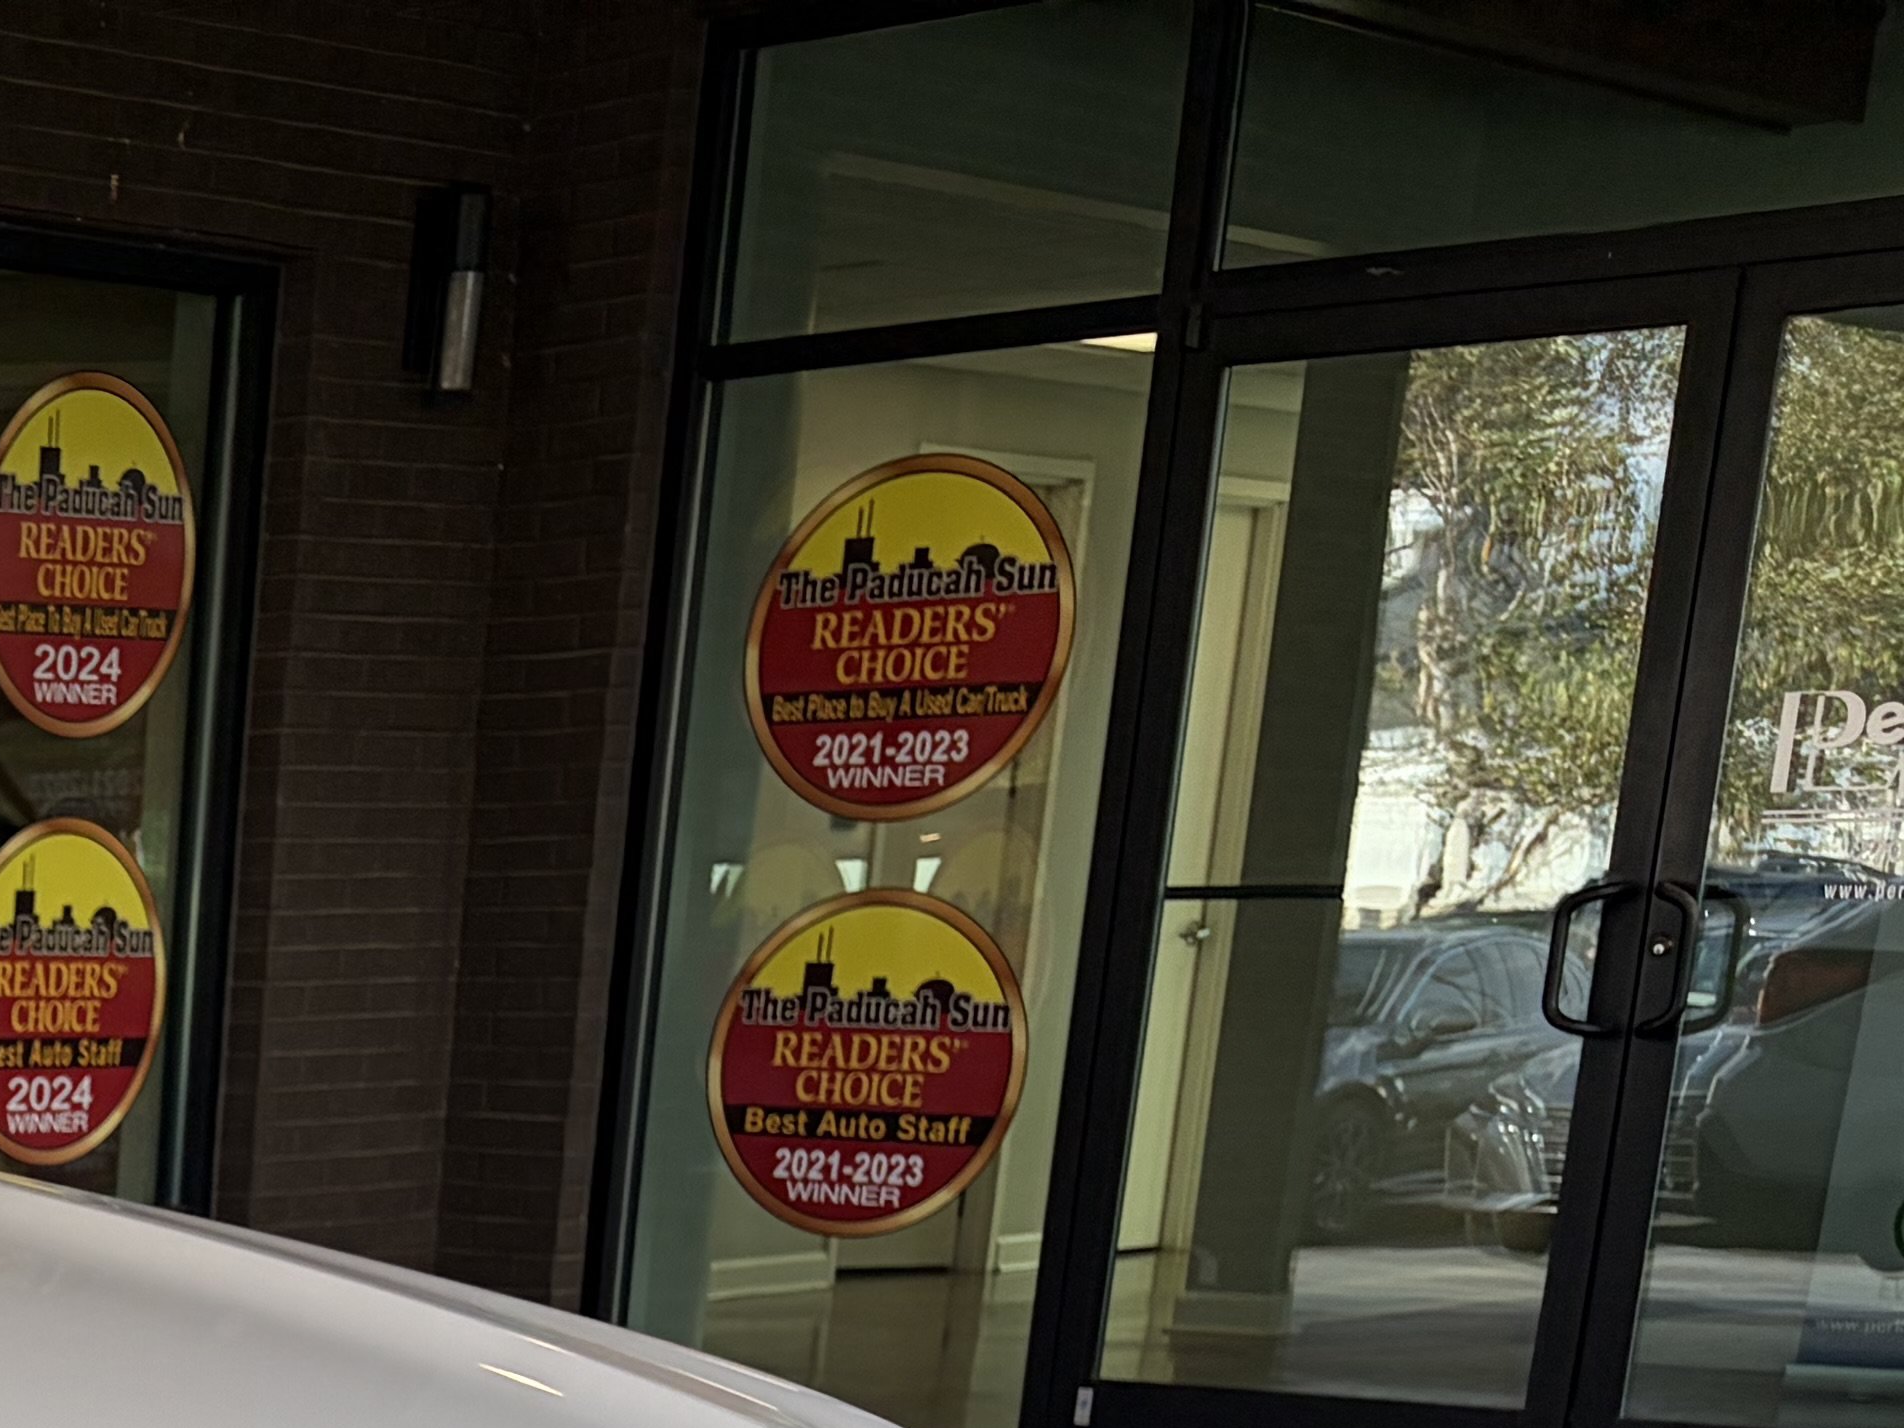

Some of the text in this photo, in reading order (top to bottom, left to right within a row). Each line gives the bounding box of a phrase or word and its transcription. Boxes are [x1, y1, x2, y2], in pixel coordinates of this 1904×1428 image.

[42, 473, 137, 520] Paducah
[141, 484, 184, 525] Sun
[36, 563, 130, 601] CHOICE
[779, 556, 1060, 610] The Paducah Sun
[33, 644, 122, 682] 2024
[836, 644, 969, 685] CHOICE
[33, 680, 117, 706] WINNER
[813, 729, 969, 767] 2021-2023
[827, 764, 946, 788] WINNER
[15, 915, 111, 958] Paducah
[114, 920, 154, 958] Sun
[11, 999, 103, 1034] CHOICE
[742, 986, 1012, 1033] The Paducah Sun
[29, 1039, 73, 1068] Auto
[77, 1038, 123, 1067] Staff
[6, 1075, 93, 1112] 2024
[795, 1069, 925, 1109] CHOICE
[6, 1110, 89, 1134] WINNER
[744, 1107, 972, 1144] Best Auto Staff
[773, 1147, 924, 1187] 2021-2023
[786, 1180, 901, 1208] WINNER
